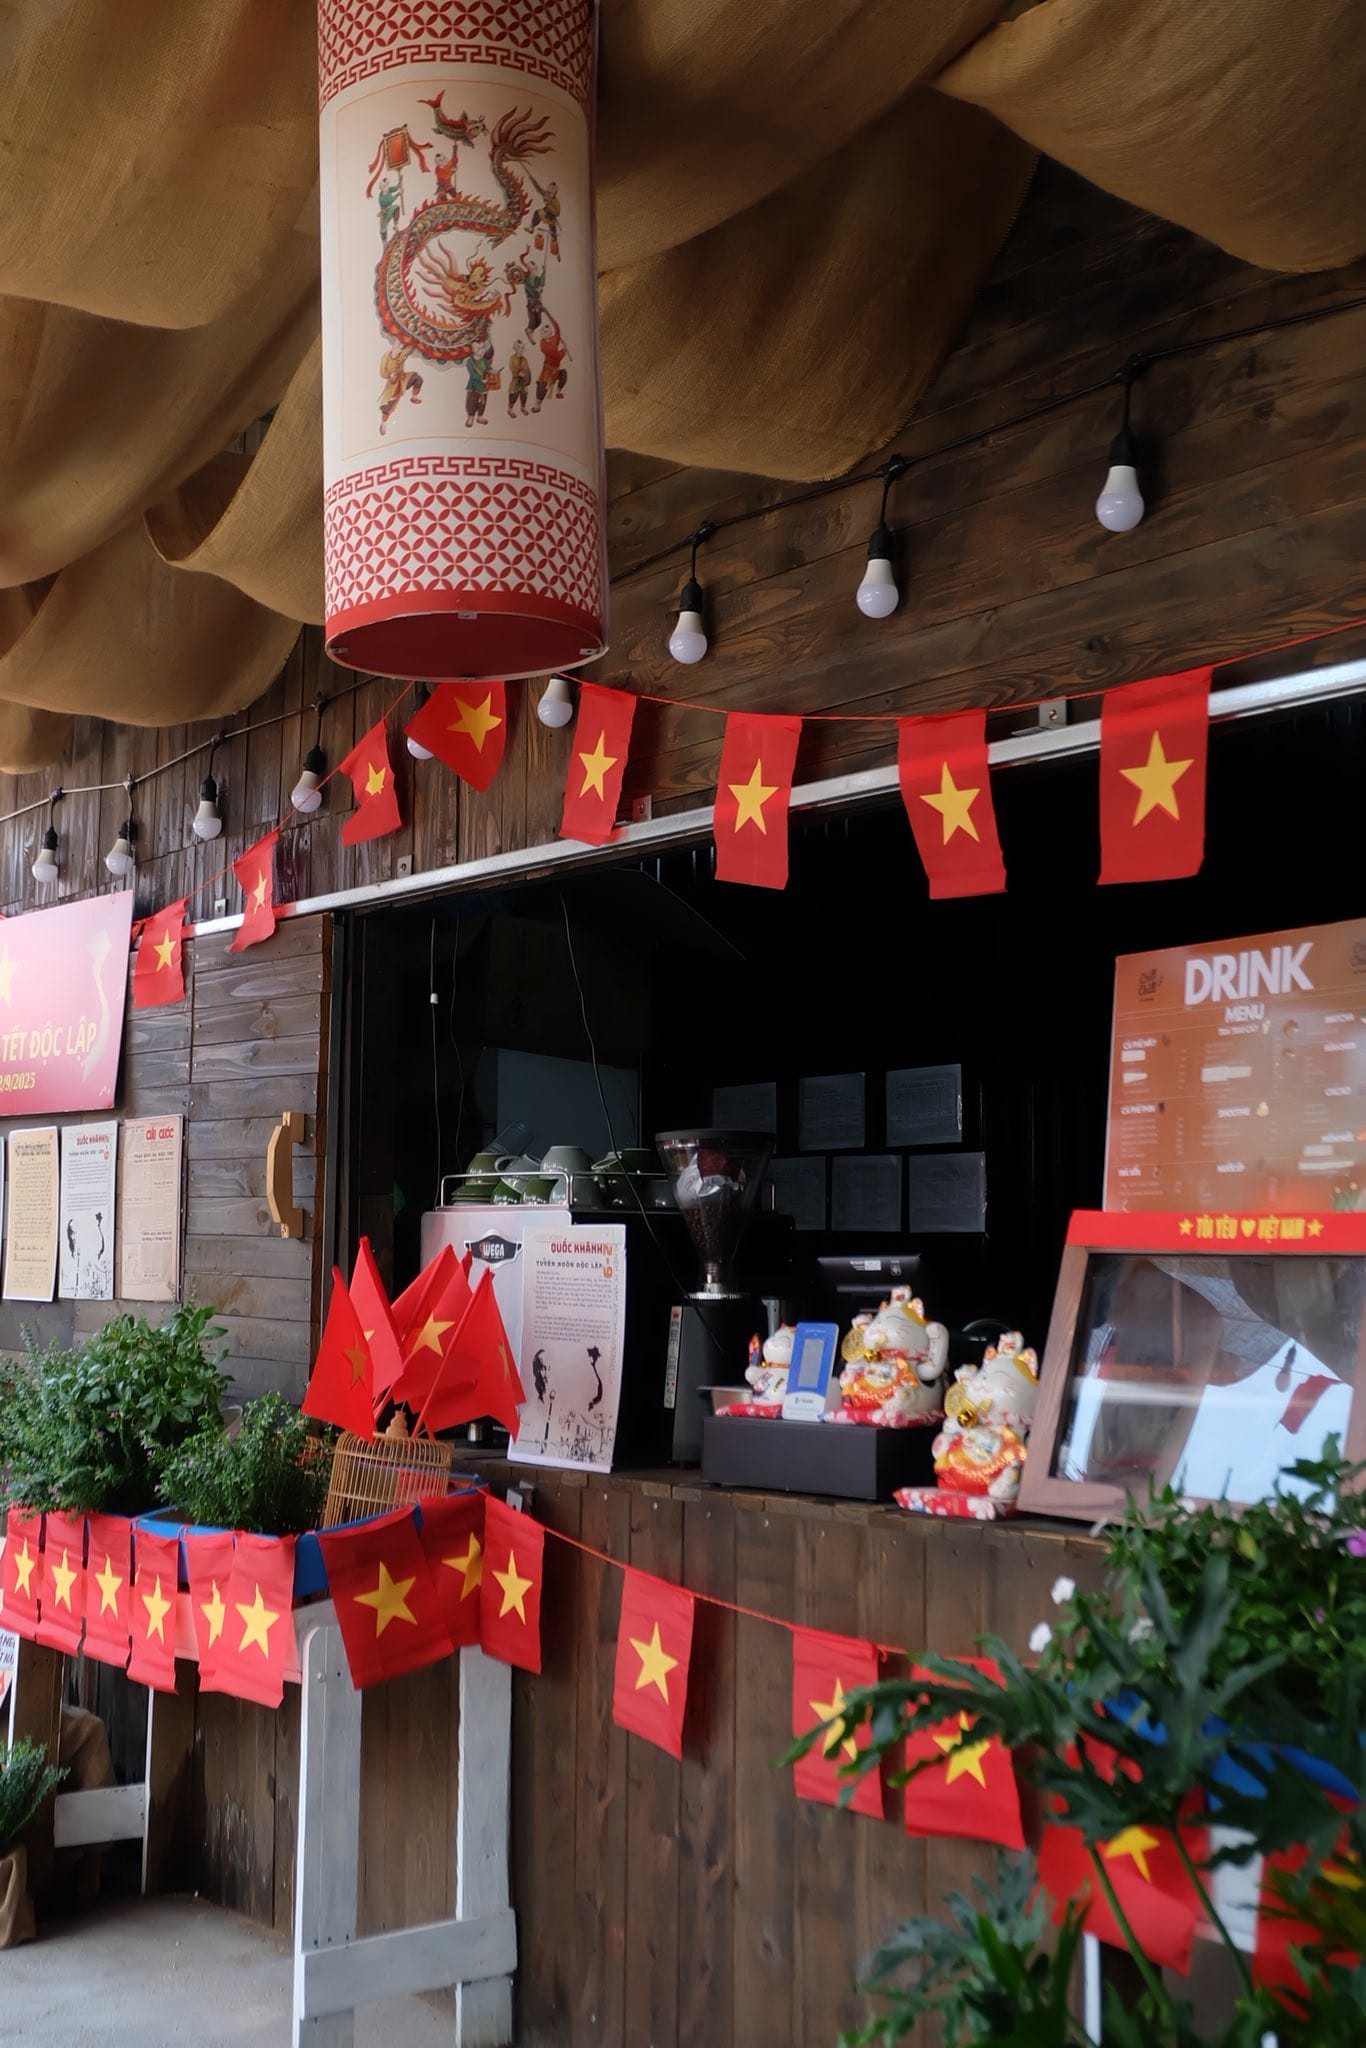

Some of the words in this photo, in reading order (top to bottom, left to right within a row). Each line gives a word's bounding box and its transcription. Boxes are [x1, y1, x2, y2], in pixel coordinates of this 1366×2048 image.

[1184, 942, 1314, 1005] DRINK
[1224, 1004, 1265, 1023] MENU
[3, 1024, 28, 1062] TẾT
[29, 1020, 63, 1066] ĐỘC
[66, 1016, 97, 1062] LẬP
[482, 1243, 505, 1257] WEGA
[551, 1238, 572, 1253] QUỐC
[574, 1241, 602, 1254] KHÁNH
